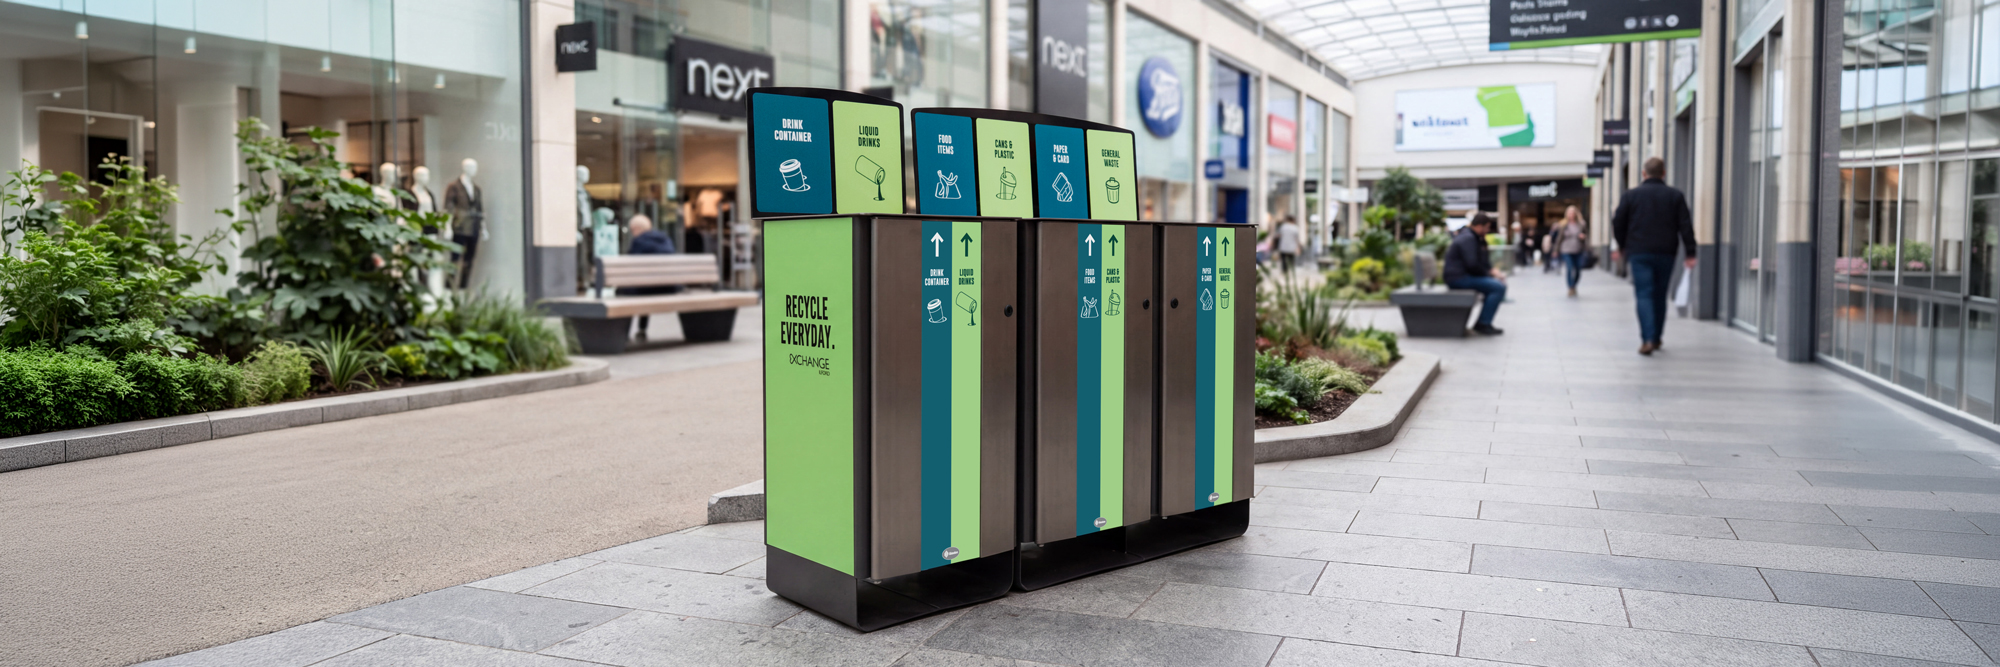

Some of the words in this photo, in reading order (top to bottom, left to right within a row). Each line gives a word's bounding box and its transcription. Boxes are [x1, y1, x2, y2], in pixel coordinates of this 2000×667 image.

[687, 57, 769, 101] next
[782, 118, 803, 130] DRINK
[858, 125, 879, 136] LIQUID
[774, 130, 812, 142] CONTAINER
[938, 134, 952, 144] FOOD
[858, 137, 881, 148] DRINKS
[995, 139, 1008, 149] CANS
[937, 144, 954, 155] ITEMS
[1053, 144, 1068, 154] PAPER
[1101, 148, 1121, 159] GENERAL
[994, 149, 1015, 160] PLASTIC
[1052, 154, 1057, 163] &
[1057, 154, 1070, 164] CARD
[1103, 158, 1119, 168] WASTE
[930, 268, 944, 277] DRINK
[959, 268, 974, 277] LIQUID
[1085, 268, 1095, 276] FOOD
[1106, 268, 1116, 276] CANS
[1201, 267, 1212, 275] PAPER
[1218, 267, 1231, 275] GENERAL
[924, 278, 949, 286] CONTAINER
[1084, 276, 1096, 284] ITEMS
[1105, 276, 1120, 284] PLASTIC
[786, 294, 828, 320] RECYCLE
[781, 321, 835, 349] EVERYDAY.
